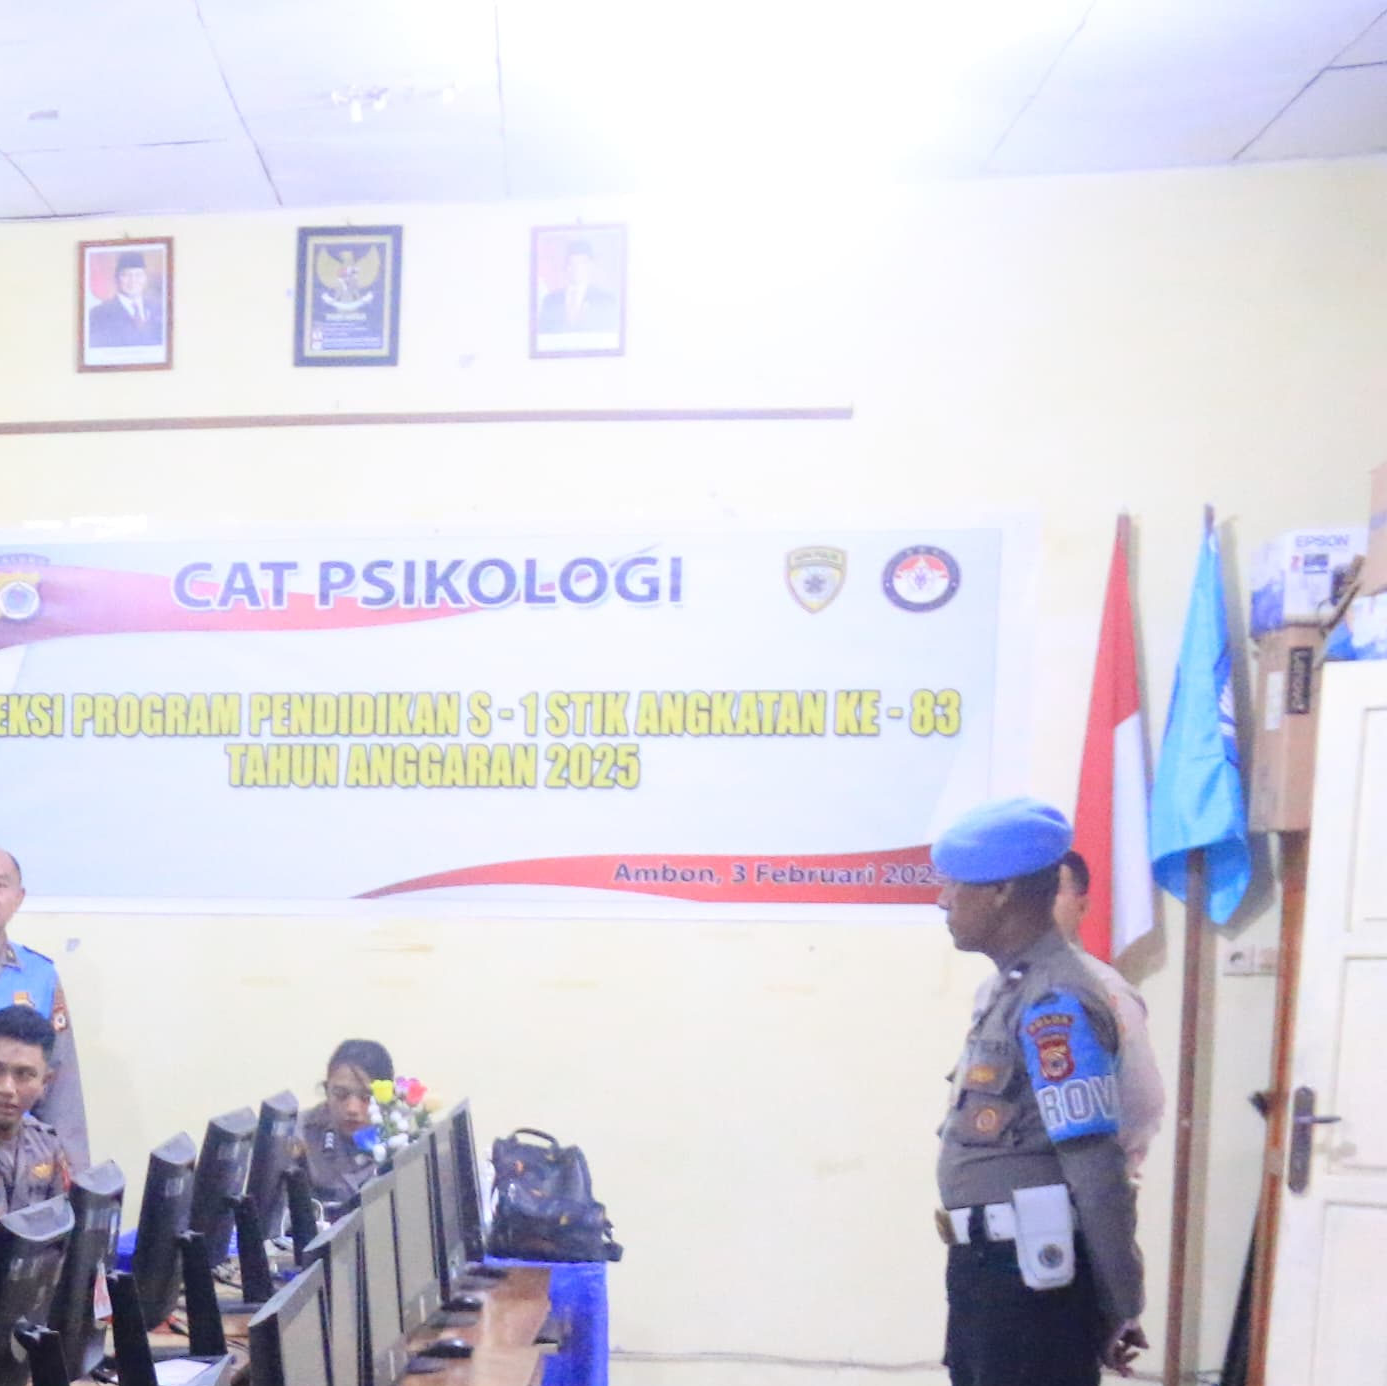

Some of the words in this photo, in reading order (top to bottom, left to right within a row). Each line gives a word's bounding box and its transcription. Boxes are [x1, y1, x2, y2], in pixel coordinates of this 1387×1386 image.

[1294, 534, 1350, 548] EPSON
[173, 561, 299, 610] CAT
[318, 556, 684, 607] PSIKOLOGI
[72, 693, 241, 737] PROGRAM
[249, 692, 461, 737] PENDIDIKAN
[544, 691, 628, 737] STIK
[634, 690, 826, 737] ANGKATAN
[833, 689, 881, 737] KE
[908, 688, 962, 737] 83
[225, 743, 338, 788] TAHUN
[344, 743, 537, 788] ANGGARAN
[545, 743, 641, 788] 2025
[613, 863, 722, 886] Ambon,
[730, 864, 747, 884] 3
[755, 862, 875, 885] Februari
